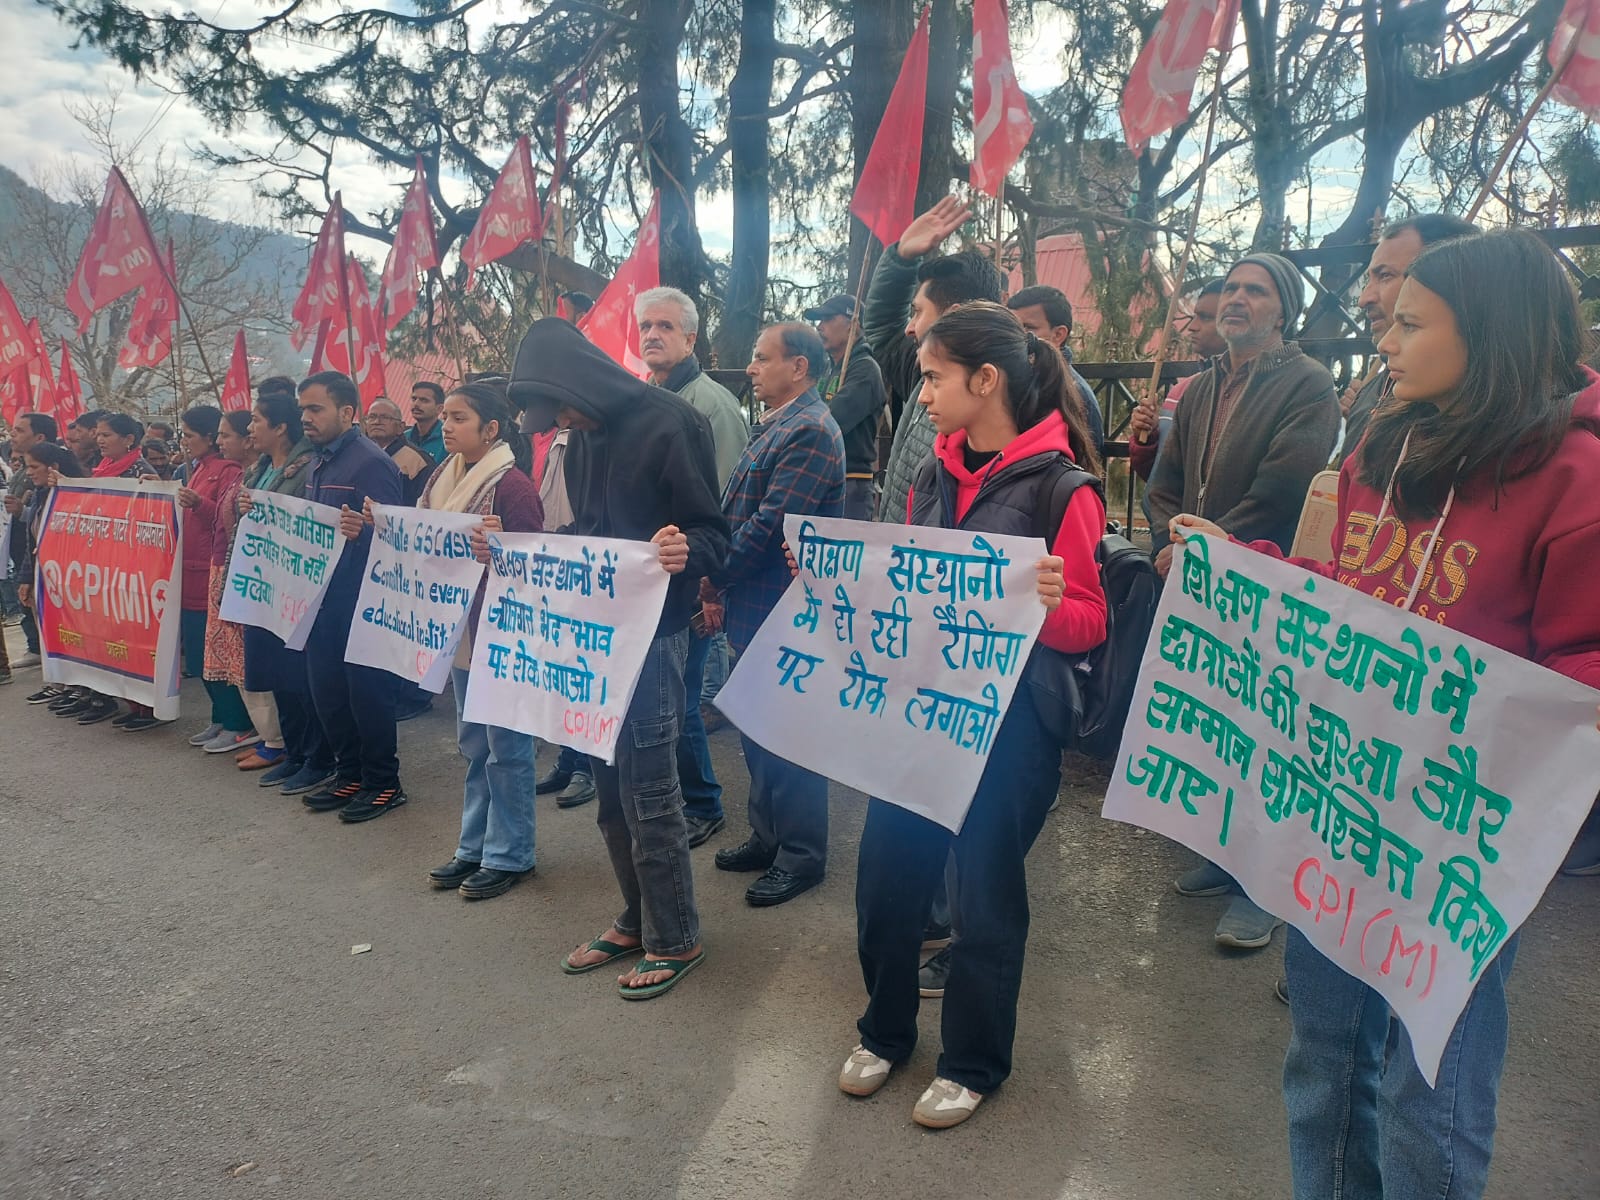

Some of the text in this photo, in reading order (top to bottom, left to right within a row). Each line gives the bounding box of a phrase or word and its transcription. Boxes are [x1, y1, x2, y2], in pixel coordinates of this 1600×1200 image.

[65, 560, 150, 630] CPI(M)
[415, 569, 424, 600] in
[429, 582, 470, 612] every
[531, 544, 597, 597] संस्थानों
[598, 549, 618, 599] में
[798, 520, 1010, 603] शिक्षण संस्थानों
[1340, 510, 1479, 607] BOSS
[793, 580, 822, 634] में
[832, 584, 856, 643] हो
[870, 595, 912, 659] रही
[1182, 535, 1487, 735] शिक्षण संस्थानों में
[487, 643, 511, 679] पर
[513, 640, 540, 688] रोक
[776, 645, 1000, 755] पर रोक लगाओ
[1146, 680, 1257, 780] सम्मान
[1261, 664, 1300, 742] की
[1305, 702, 1404, 801] सुरक्षा
[1412, 744, 1512, 864] और
